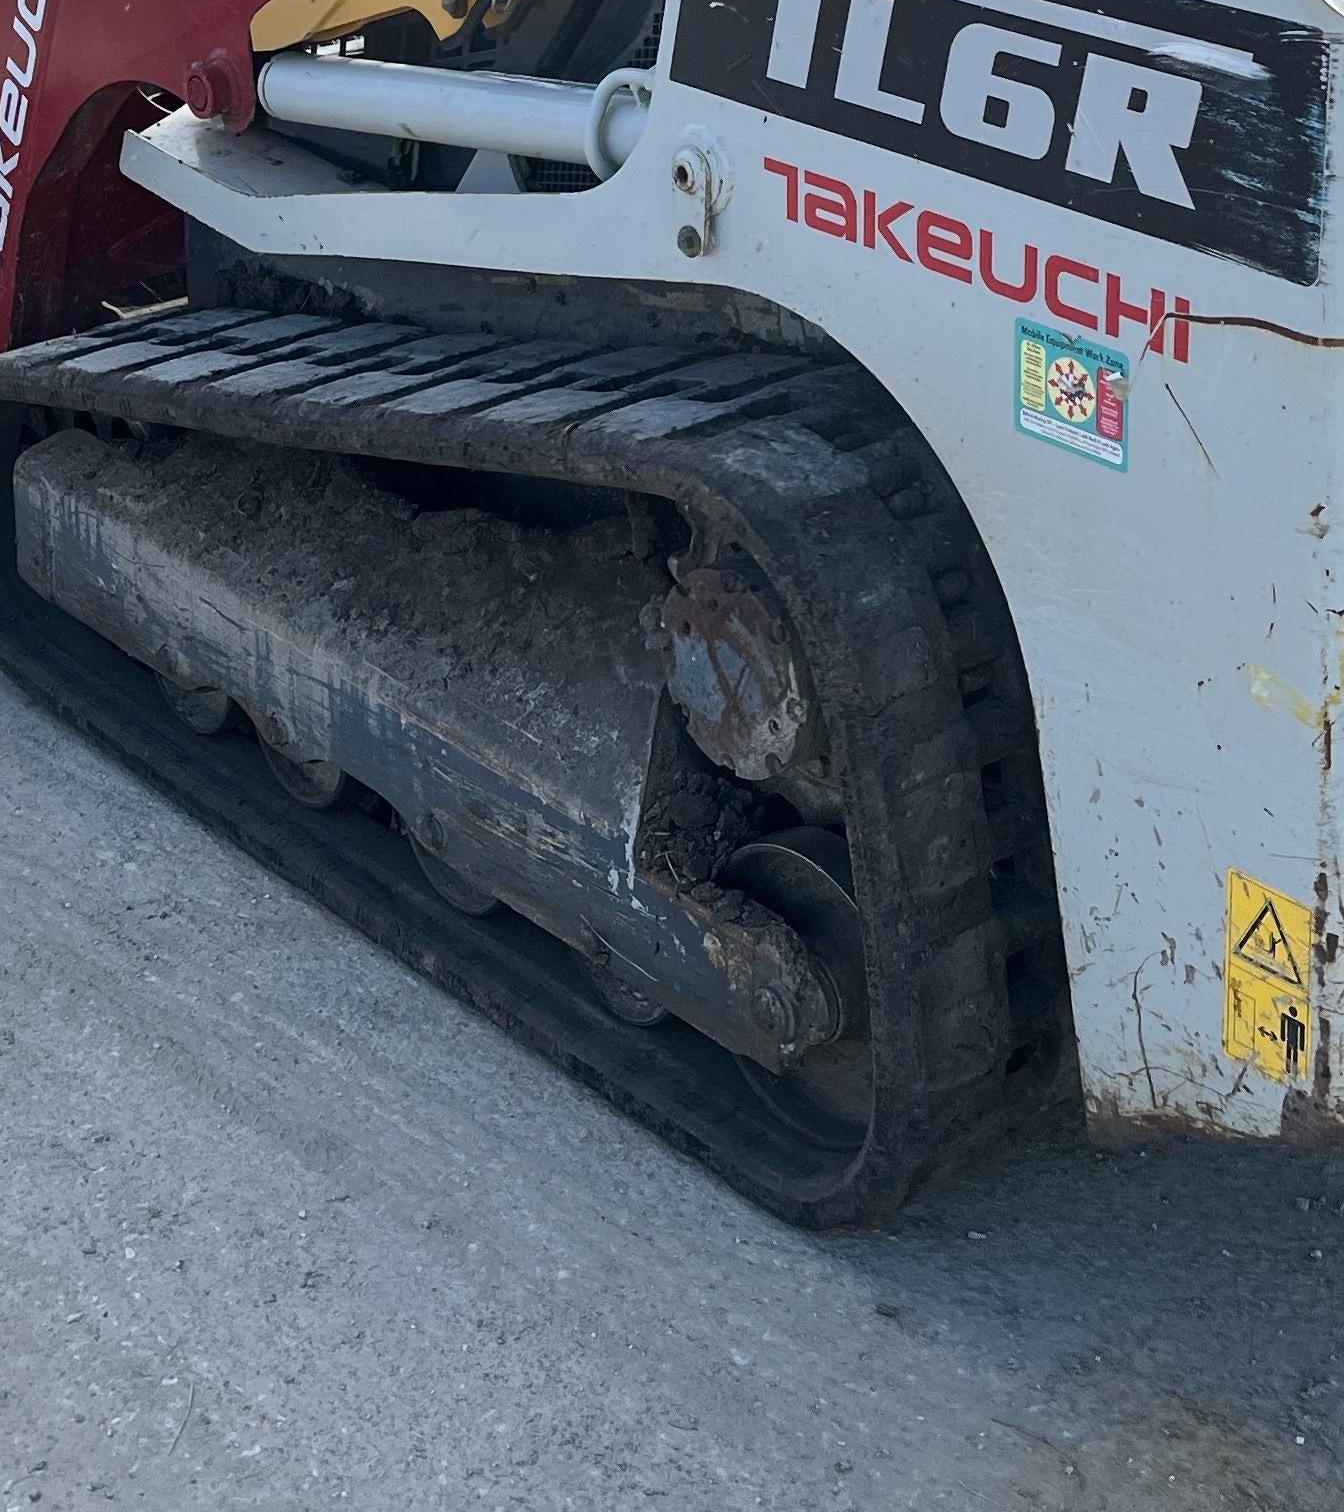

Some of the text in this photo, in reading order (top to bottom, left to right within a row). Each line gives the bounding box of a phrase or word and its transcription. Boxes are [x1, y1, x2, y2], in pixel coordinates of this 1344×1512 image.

[763, 156, 1191, 363] TAKEUCHI
[1021, 325, 1045, 342] Mobile
[1085, 347, 1105, 364] Work
[1105, 355, 1124, 369] Zone
